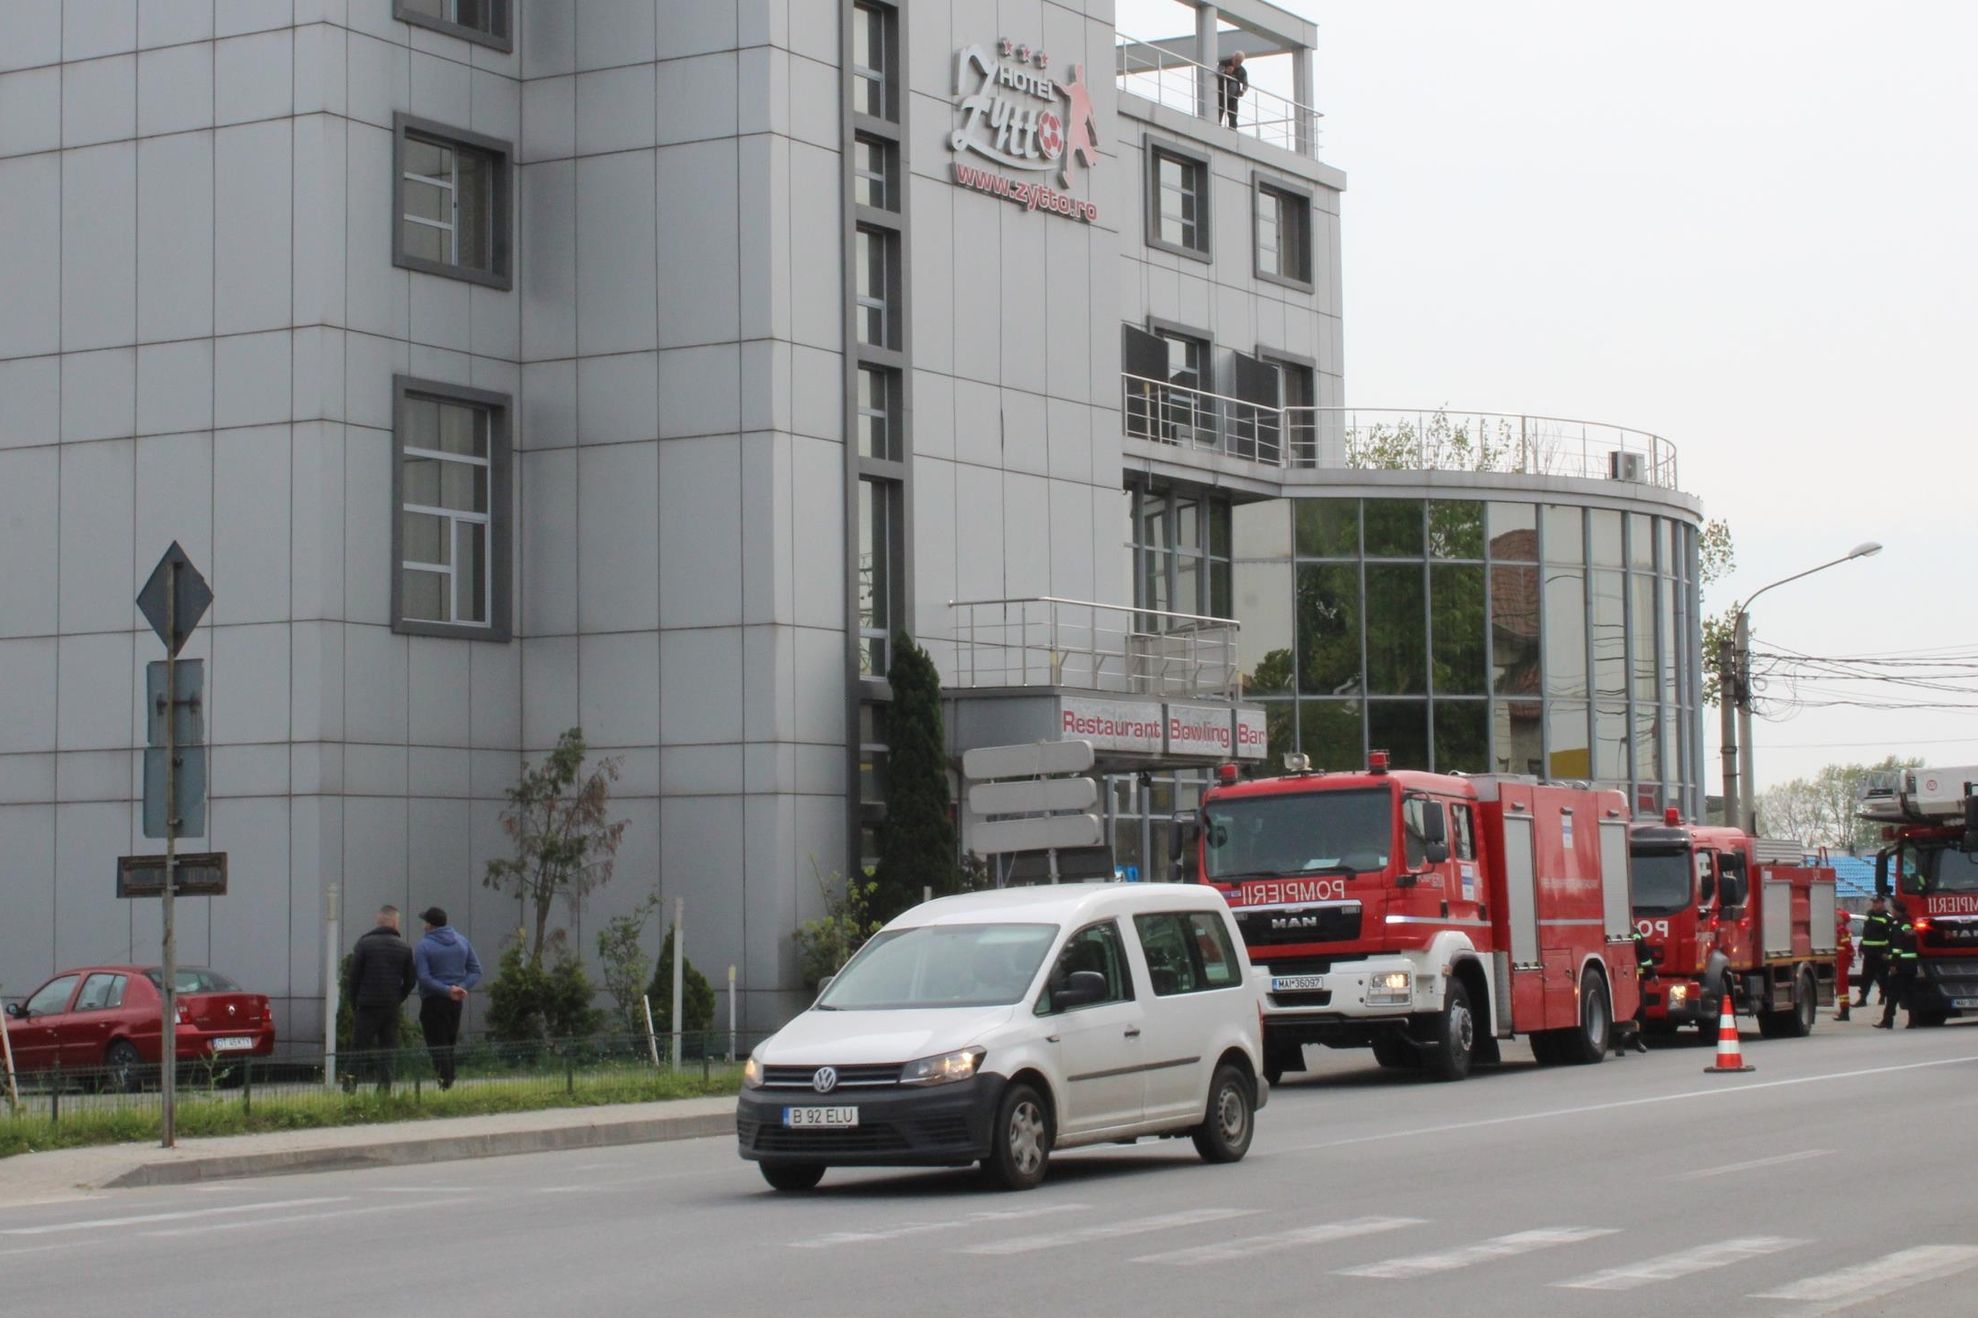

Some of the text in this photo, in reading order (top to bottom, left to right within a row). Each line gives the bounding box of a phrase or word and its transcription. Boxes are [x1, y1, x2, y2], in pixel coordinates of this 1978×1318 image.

[1000, 67, 1056, 102] HOTEL
[956, 162, 1098, 221] www.zytto.ro
[1063, 710, 1264, 748] Restaurant Bowling Bar
[1271, 916, 1318, 929] MAN
[793, 1108, 853, 1124] B 92 ELU
